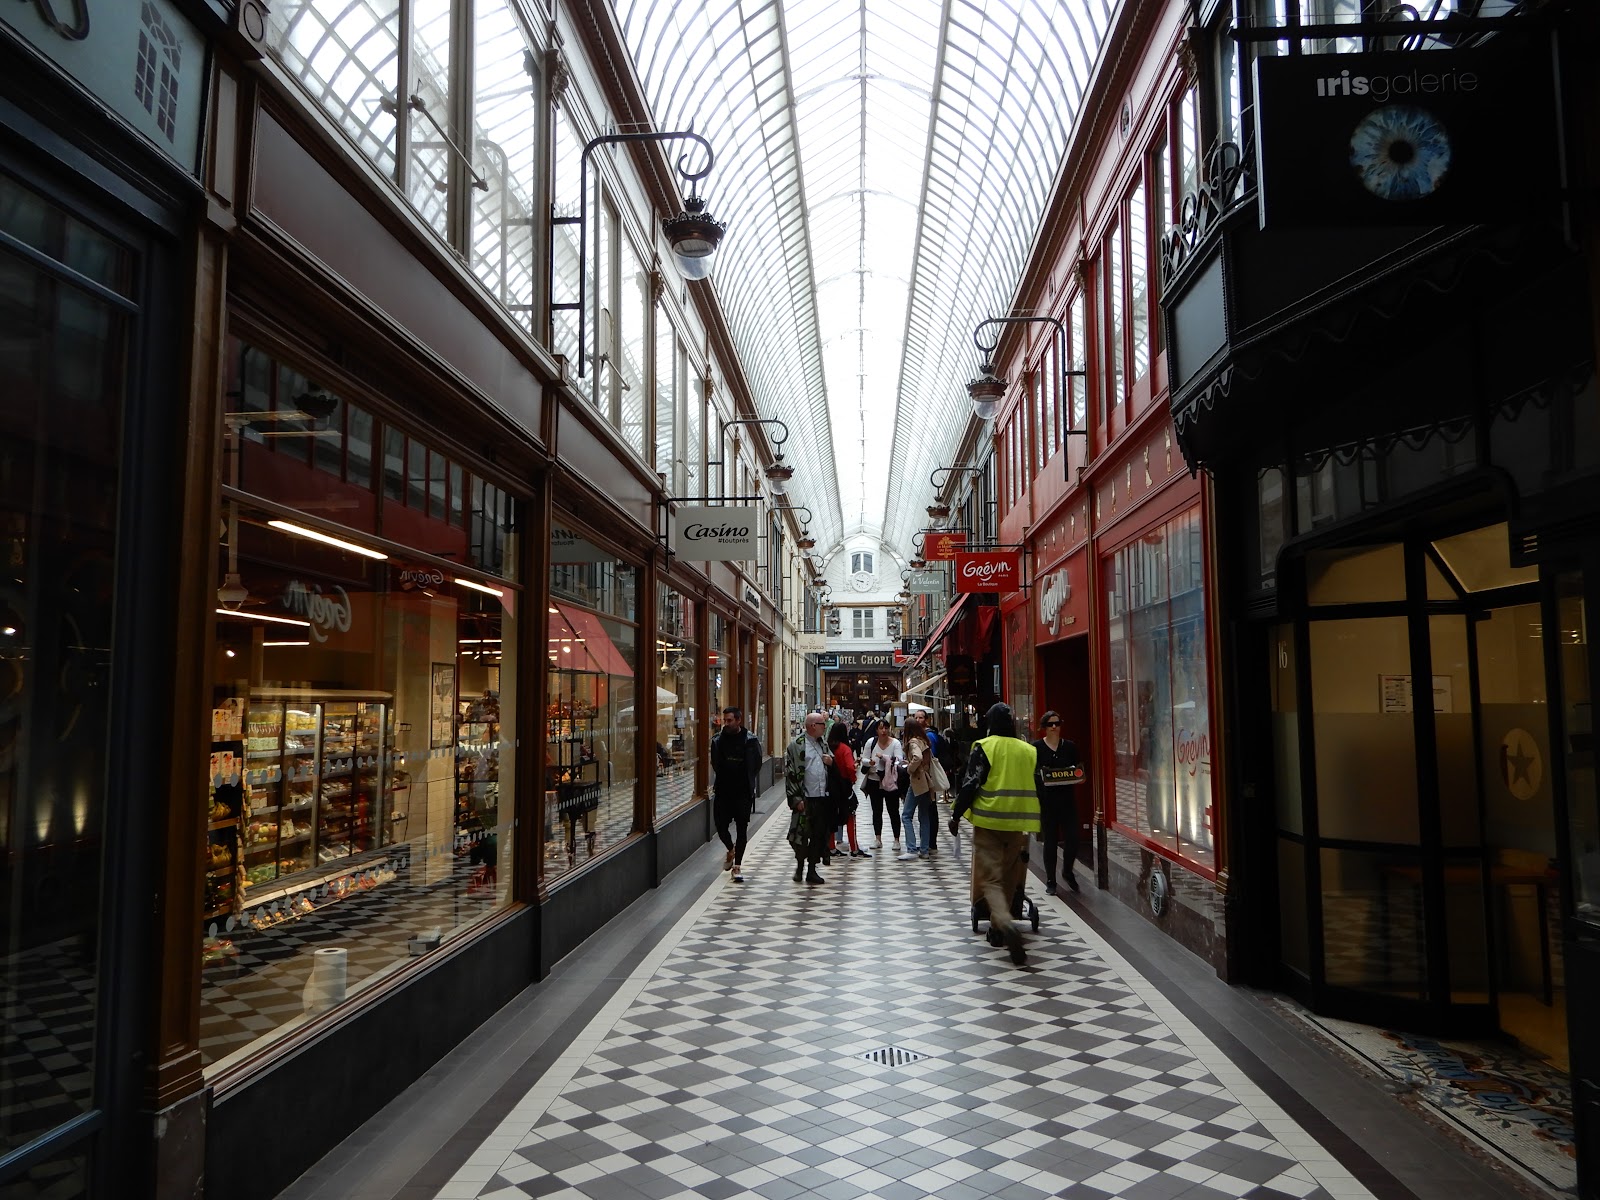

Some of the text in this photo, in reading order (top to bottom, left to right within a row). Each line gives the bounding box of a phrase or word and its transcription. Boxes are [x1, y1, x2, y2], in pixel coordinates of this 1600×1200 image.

[684, 523, 749, 541] Casino
[963, 560, 1012, 579] Grévin
[840, 654, 857, 665] ÔTEL
[861, 654, 892, 665] CHOPI
